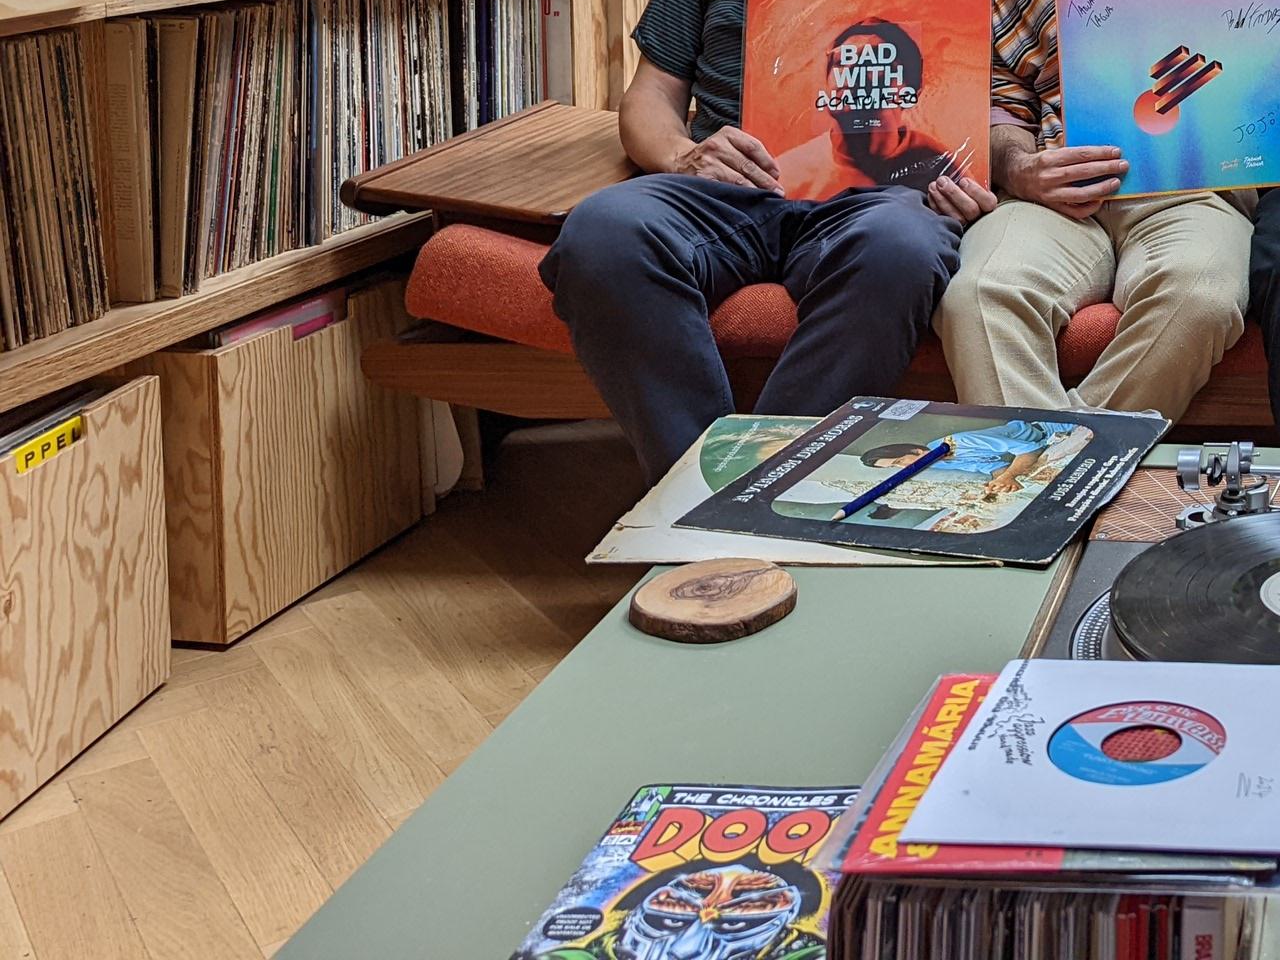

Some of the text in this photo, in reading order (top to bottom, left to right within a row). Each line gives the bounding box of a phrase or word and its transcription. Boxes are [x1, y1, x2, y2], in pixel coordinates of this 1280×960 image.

[840, 43, 897, 65] BAD
[833, 65, 904, 88] WITH
[818, 87, 917, 111] NAMES
[869, 679, 981, 859] ANNAMÁRIA
[673, 792, 712, 804] THE
[716, 793, 837, 807] CHRONICLES
[629, 807, 842, 872] DOO
